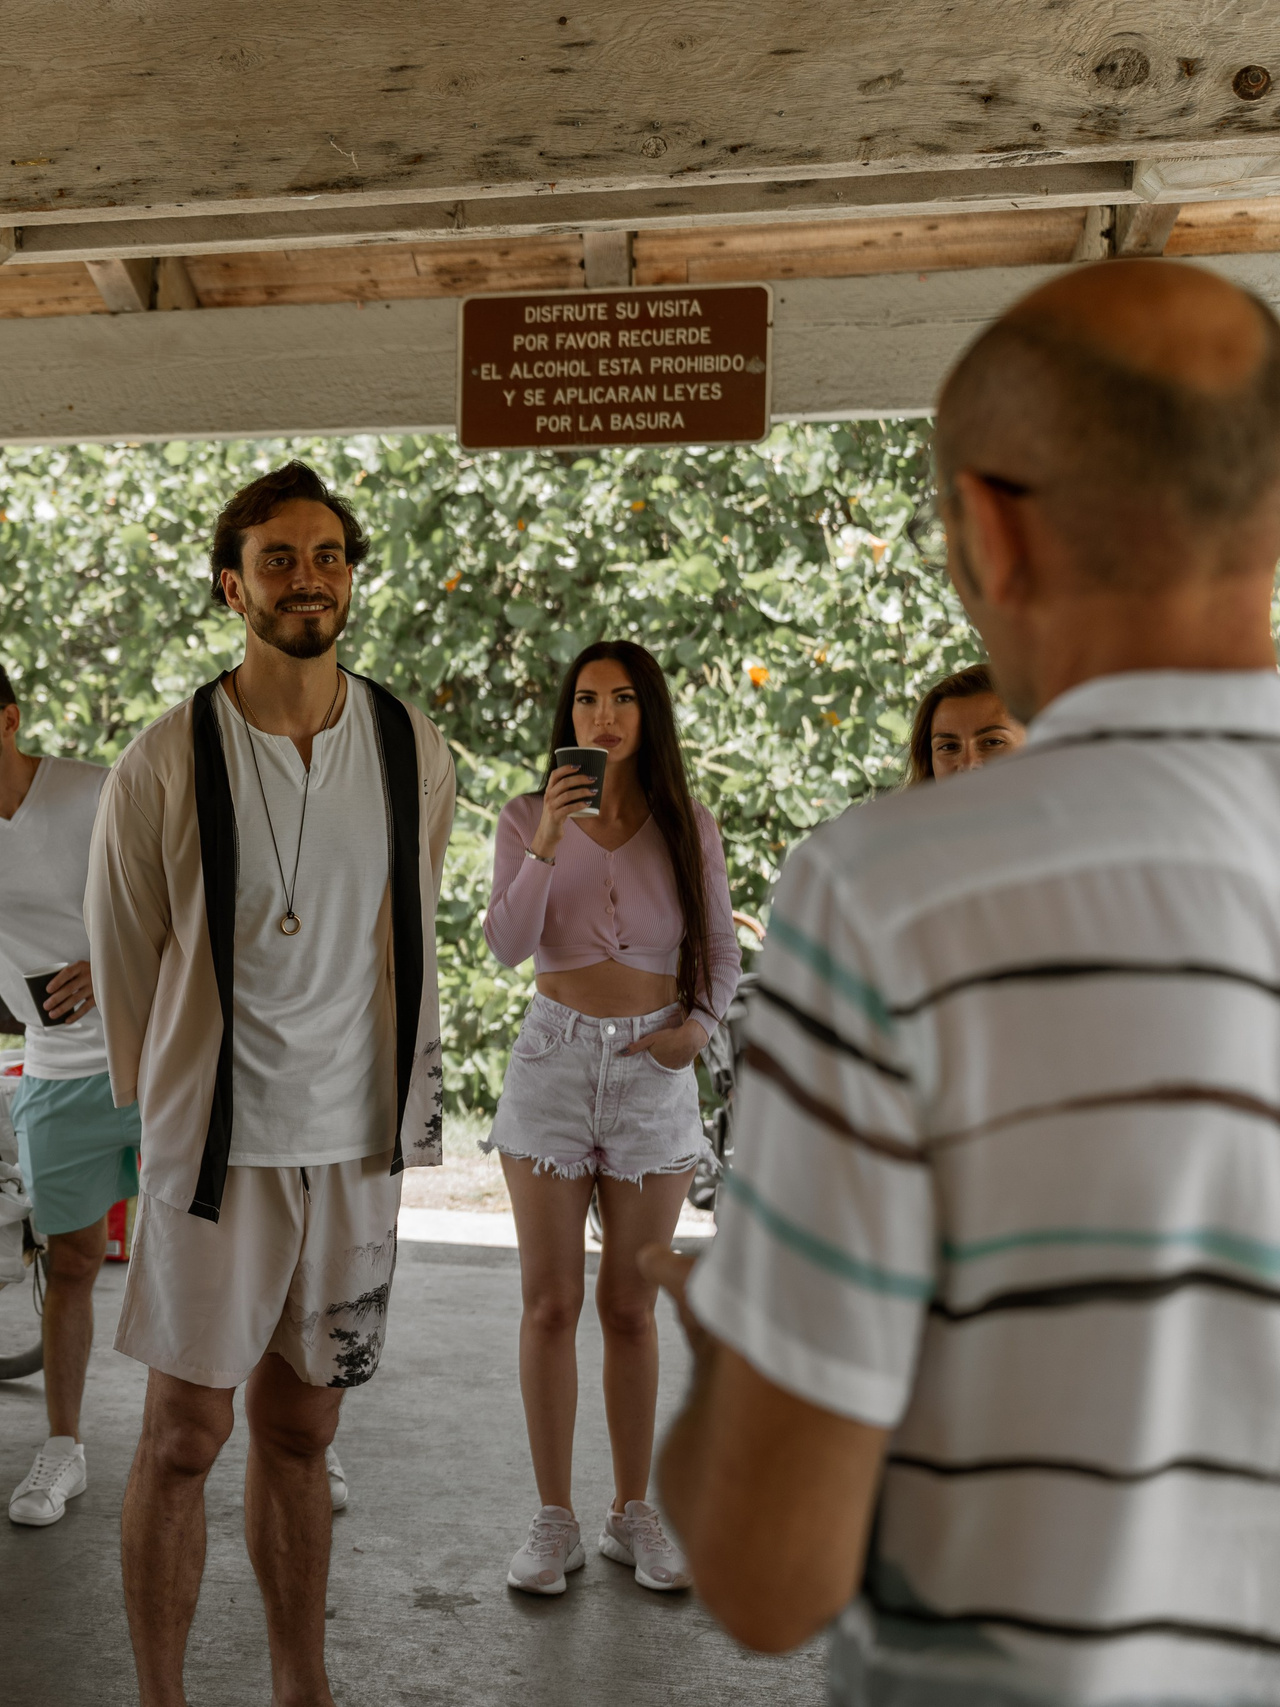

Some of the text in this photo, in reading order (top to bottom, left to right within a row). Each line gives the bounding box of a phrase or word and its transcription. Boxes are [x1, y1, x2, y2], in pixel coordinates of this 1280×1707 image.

[525, 299, 702, 323] DISFRUTE SU VISITA
[513, 327, 711, 352] POR FAVOR RECUERDE
[480, 354, 744, 381] EL ALCOHOL ESTA PROHIBIDO
[503, 383, 722, 407] Y SE APLICARAN LEYES
[536, 411, 685, 433] POR LA BASURA
